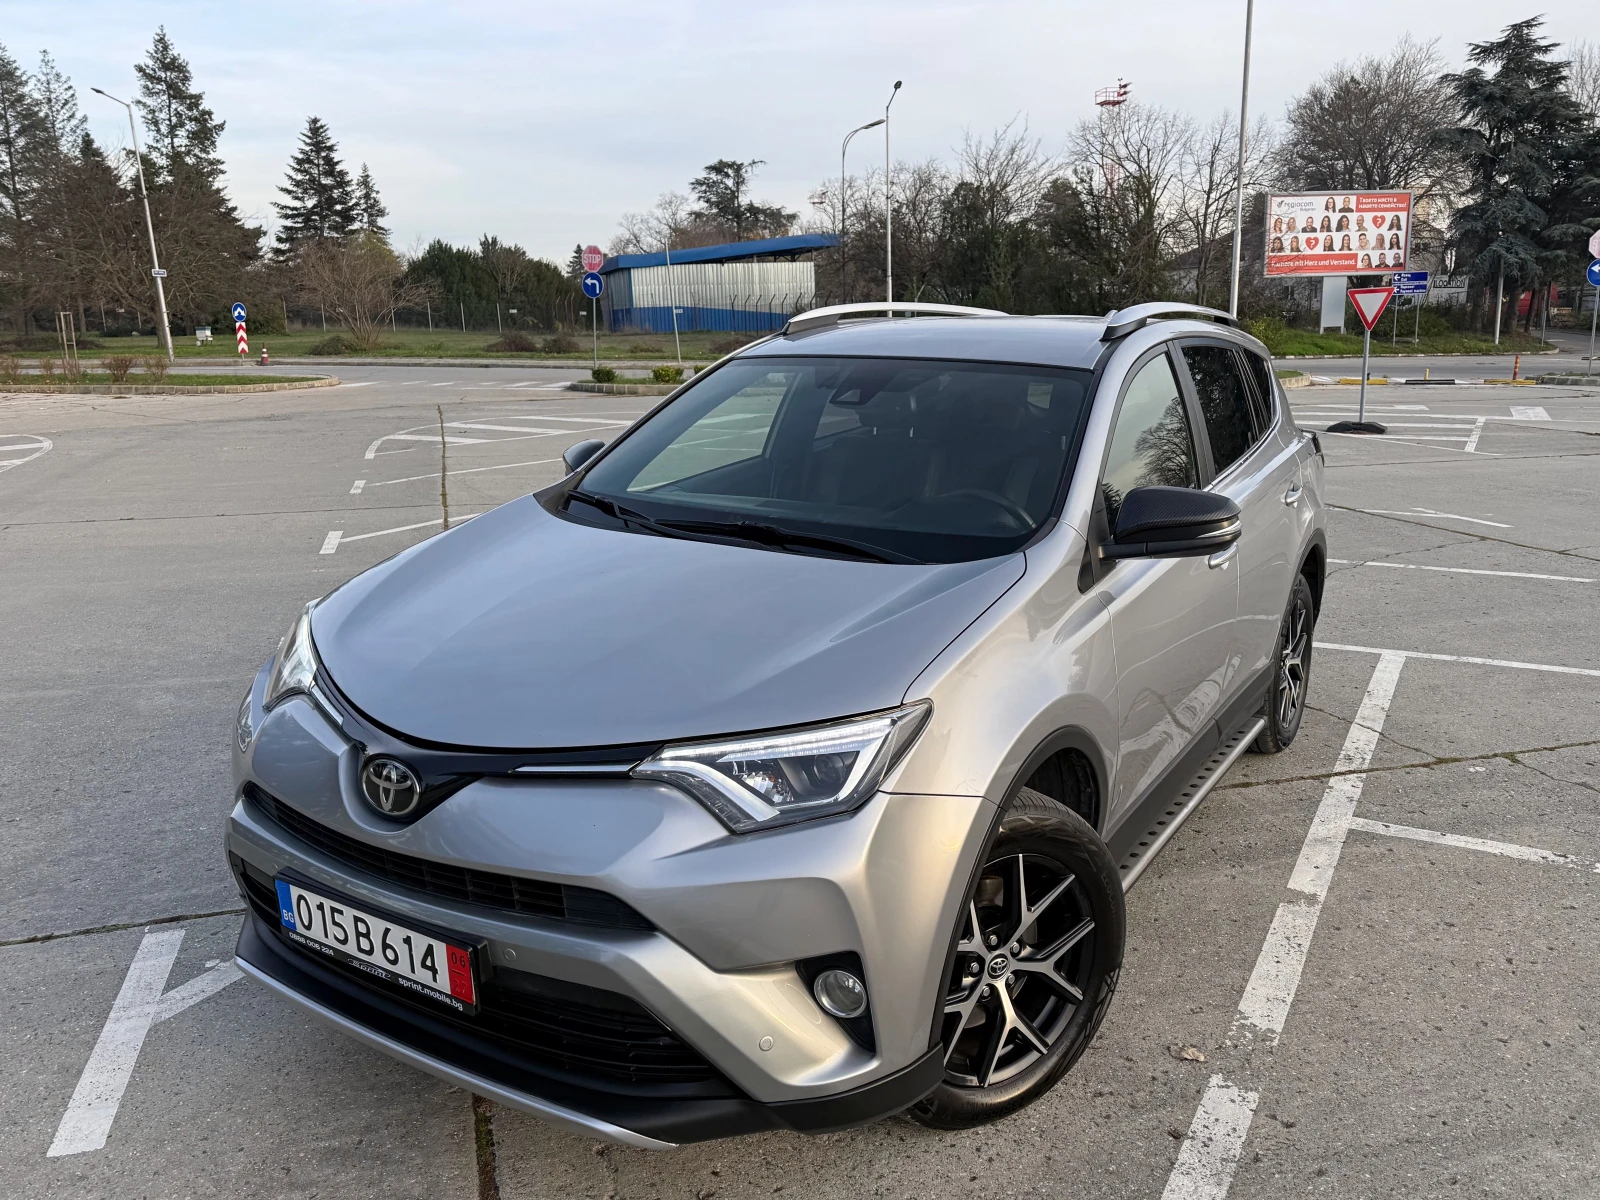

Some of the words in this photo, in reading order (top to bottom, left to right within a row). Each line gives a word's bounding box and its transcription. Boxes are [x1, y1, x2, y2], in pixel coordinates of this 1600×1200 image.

[583, 254, 601, 264] STOP
[1304, 259, 1318, 267] Herz
[1330, 258, 1356, 266] Verstand.
[282, 909, 295, 923] BG
[296, 893, 441, 984] 015B614
[451, 951, 466, 968] 06
[398, 977, 463, 1011] sprint.mobile.bg
